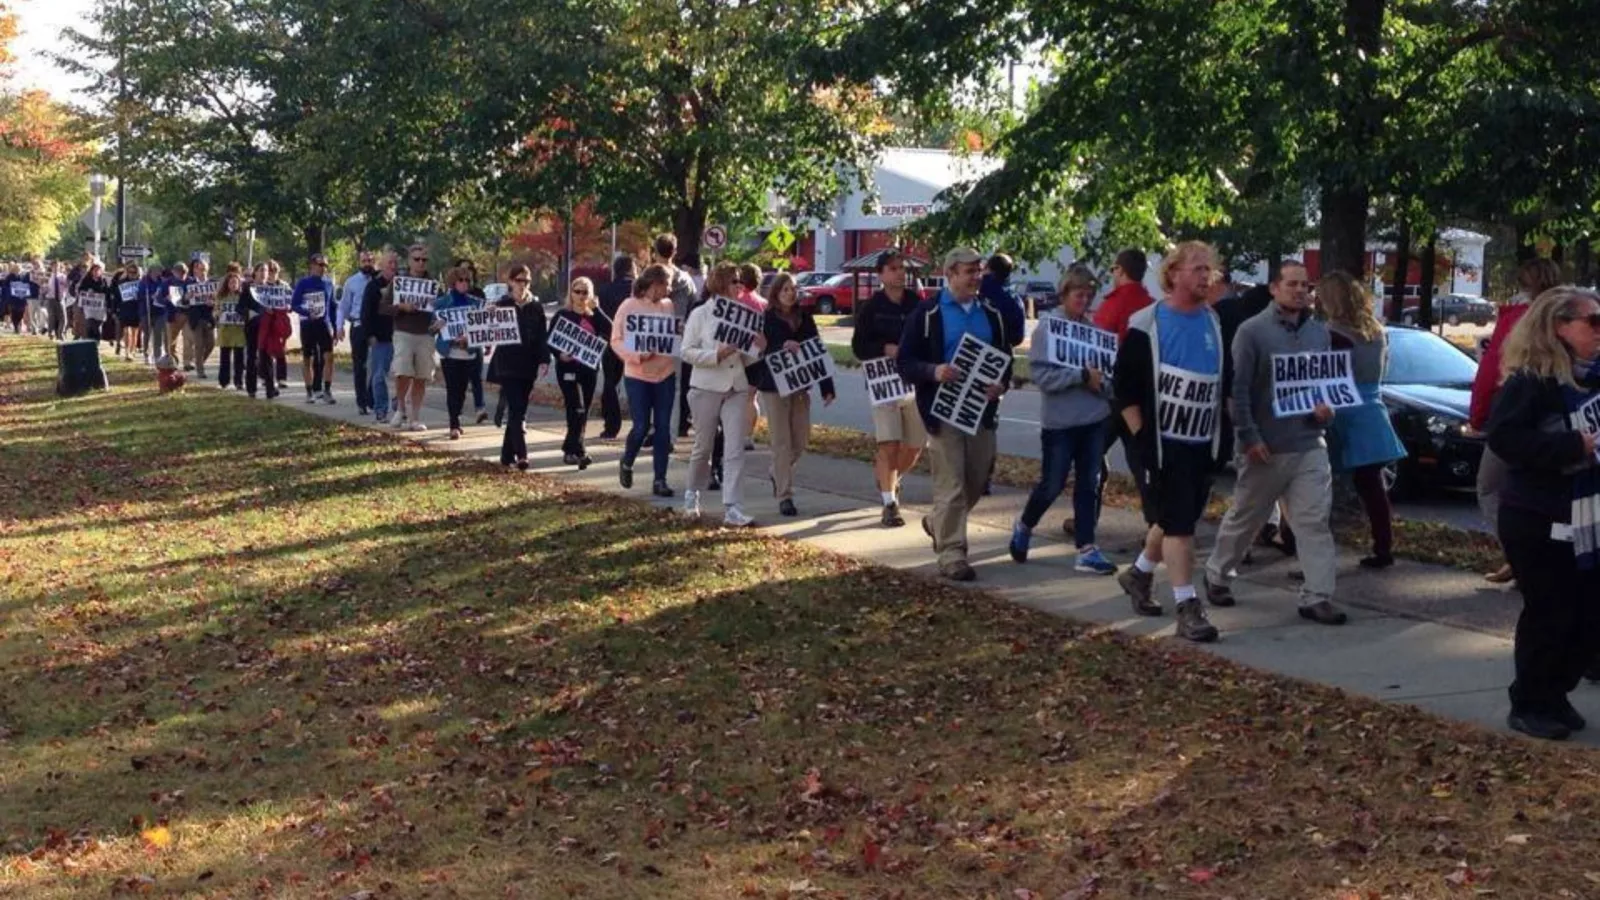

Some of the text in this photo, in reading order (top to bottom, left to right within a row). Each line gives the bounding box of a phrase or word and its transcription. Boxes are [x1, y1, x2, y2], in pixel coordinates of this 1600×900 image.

[881, 204, 932, 216] DEPARTMENT
[395, 278, 438, 295] SETTLE
[400, 293, 430, 309] NOW
[467, 310, 515, 325] SUPPORT
[626, 314, 683, 334] SETTLE
[713, 298, 764, 332] SETTLE
[469, 328, 518, 343] TEACHERS
[551, 333, 597, 365] WITH US
[556, 319, 604, 353] BARGAIN
[634, 334, 674, 353] NOW
[714, 322, 755, 352] NOW
[1050, 318, 1116, 351] WE ARE THE
[769, 338, 827, 373] SETTLE
[1056, 339, 1113, 371] UNION
[1275, 354, 1348, 382] BARGAIN
[785, 359, 827, 390] NOW
[1158, 372, 1213, 402] WE ARE
[955, 352, 1005, 428] WITH US
[1276, 384, 1355, 412] WITH US
[1159, 401, 1215, 436] UNIO
